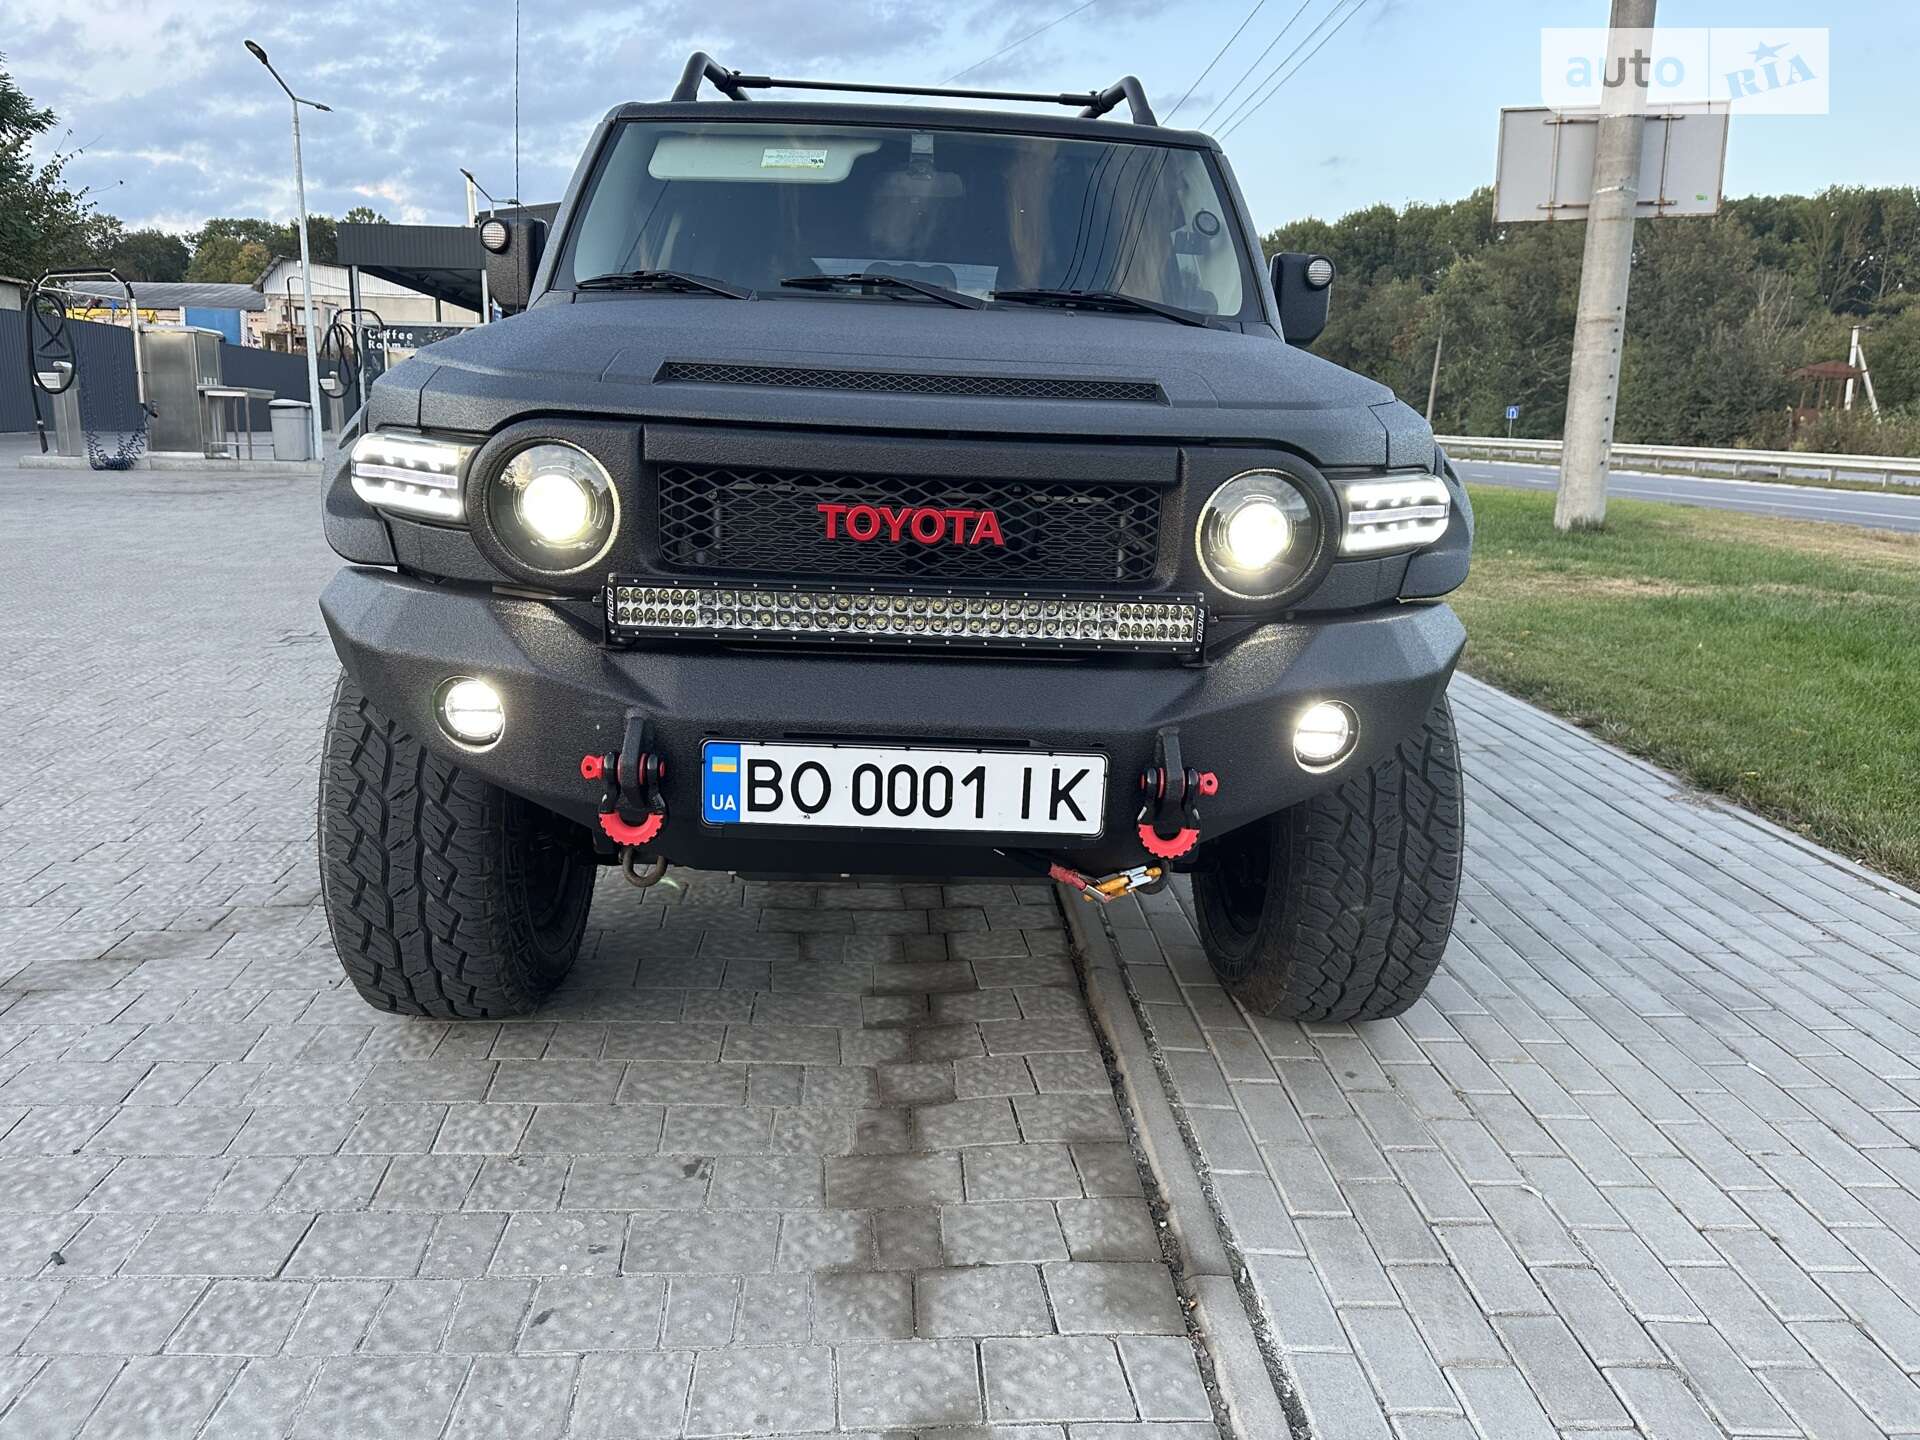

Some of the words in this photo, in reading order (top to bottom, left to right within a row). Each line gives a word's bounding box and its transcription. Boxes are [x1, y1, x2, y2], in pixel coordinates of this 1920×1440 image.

[367, 329, 413, 340] Coffee
[817, 503, 1005, 545] TOYOTA
[711, 795, 737, 811] UA
[746, 758, 832, 814] BO
[851, 763, 987, 819] 0001
[1020, 767, 1091, 822] IK
